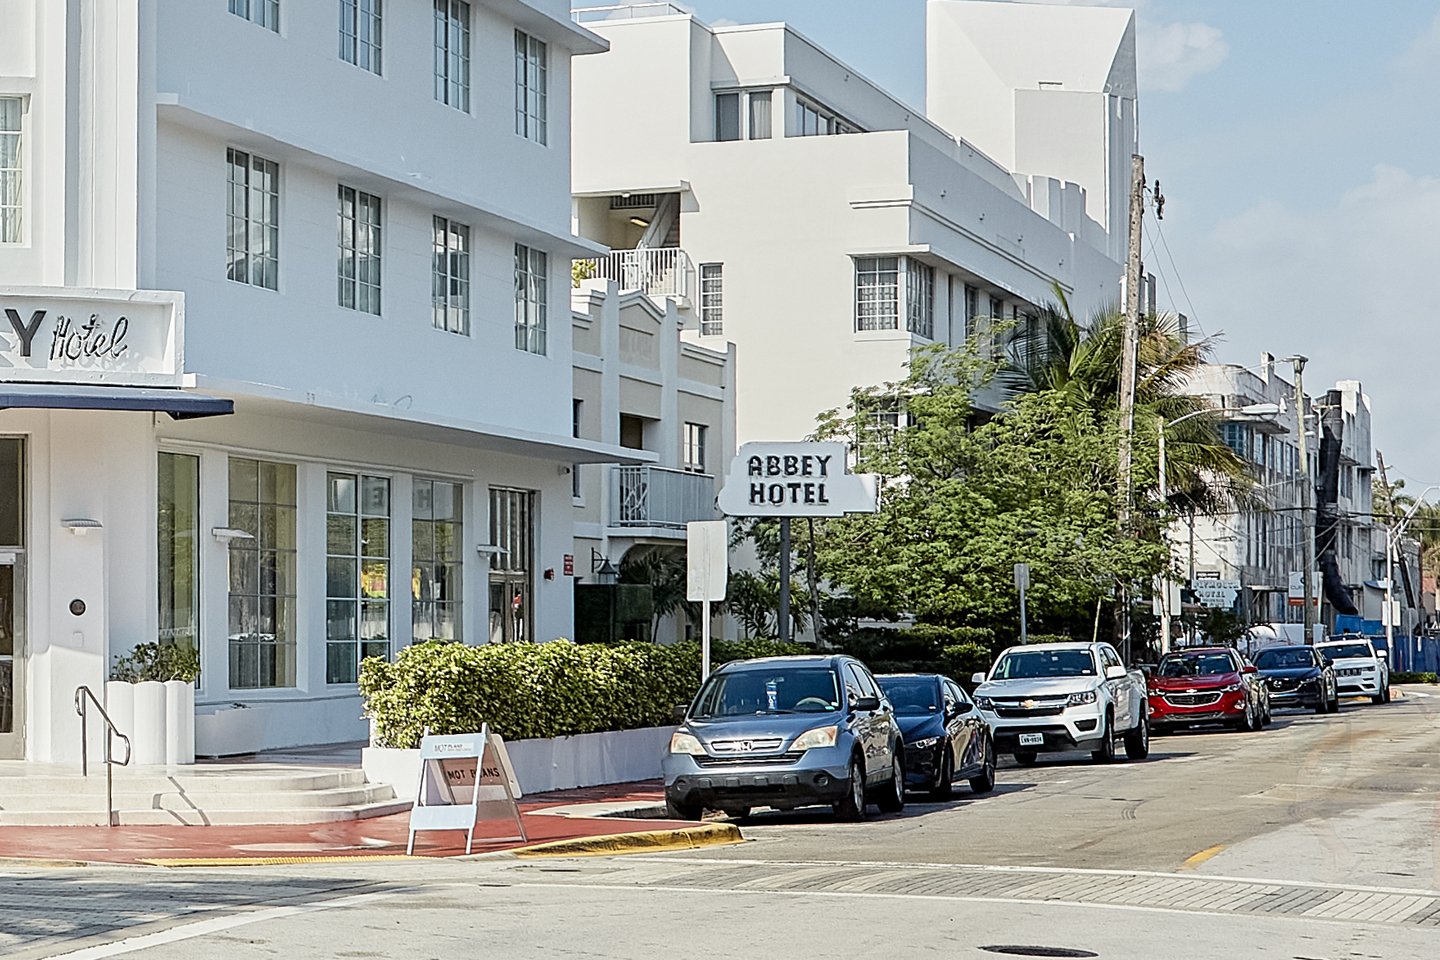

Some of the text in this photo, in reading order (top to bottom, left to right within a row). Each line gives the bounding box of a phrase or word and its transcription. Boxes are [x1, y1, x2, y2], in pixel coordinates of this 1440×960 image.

[49, 313, 128, 361] Hotel
[748, 455, 832, 476] ABBEY
[749, 482, 830, 504] HOTEL
[447, 767, 500, 780] MOT PANS
